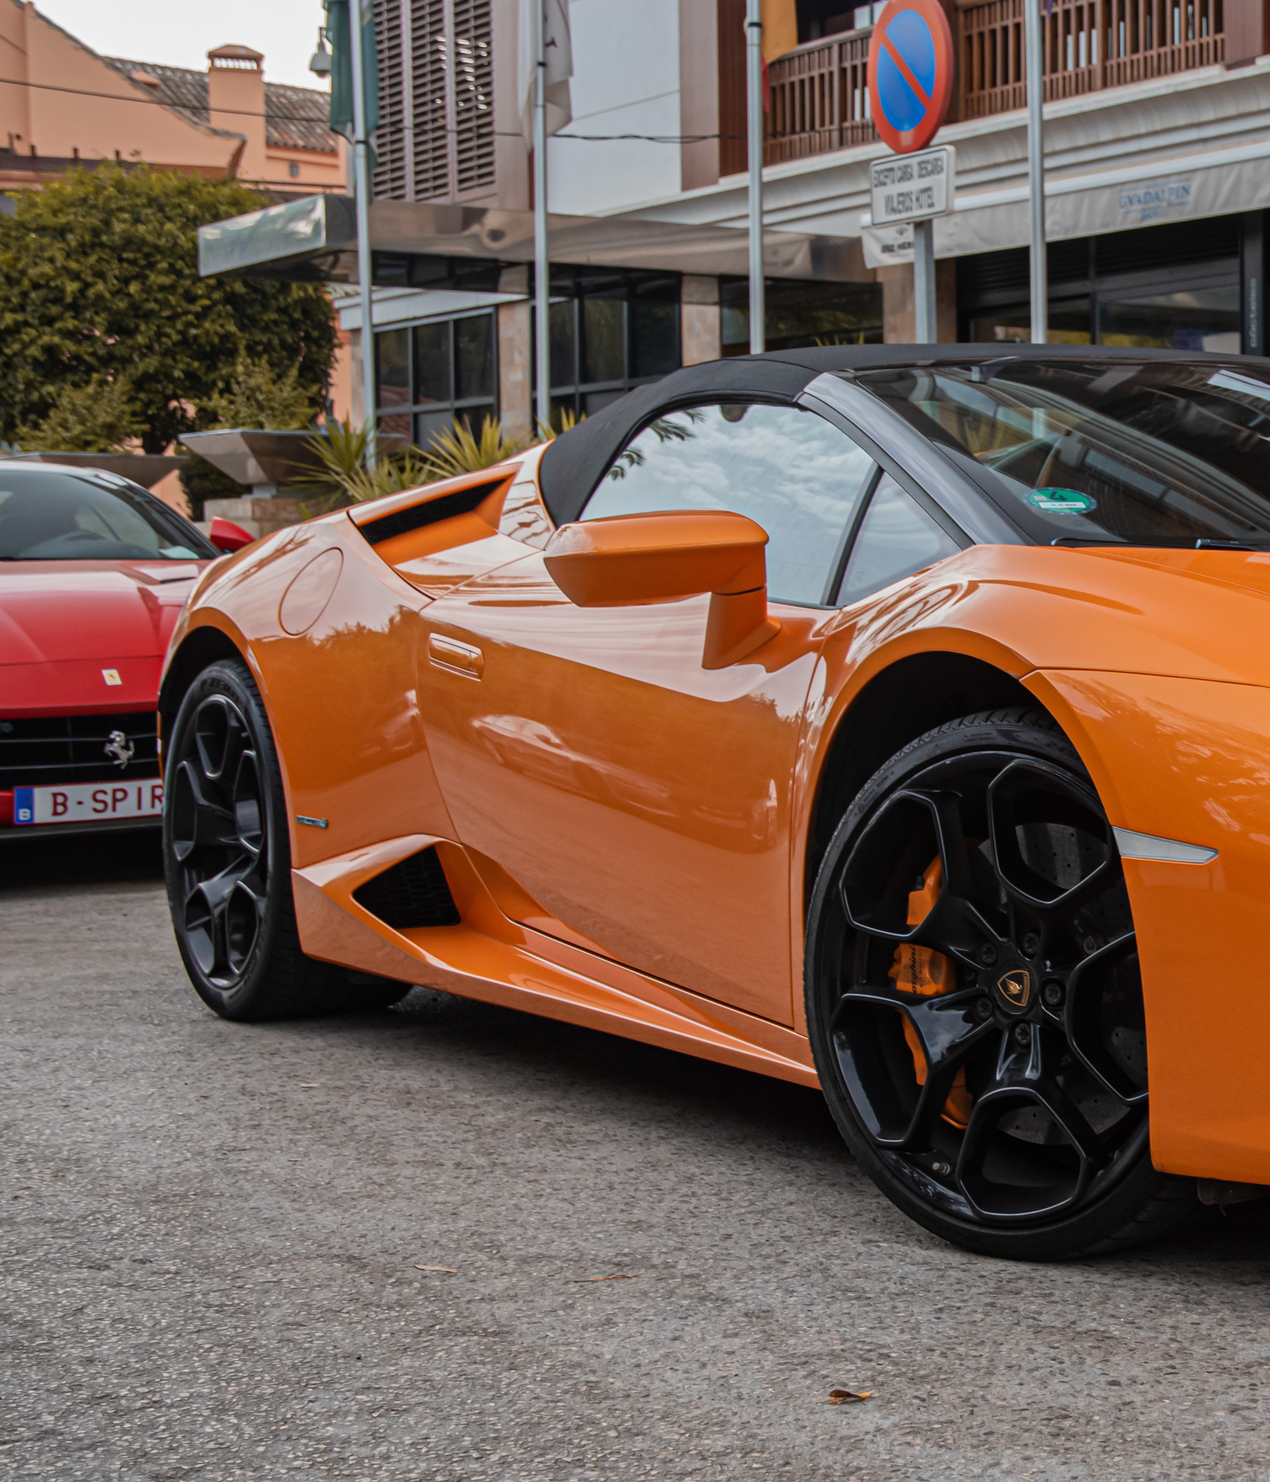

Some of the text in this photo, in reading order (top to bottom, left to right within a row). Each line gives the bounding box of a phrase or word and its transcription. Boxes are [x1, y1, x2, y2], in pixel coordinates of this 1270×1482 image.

[897, 163, 914, 183] CARGA
[915, 186, 935, 210] HOTEL
[1049, 490, 1067, 502] 4
[18, 808, 31, 821] B
